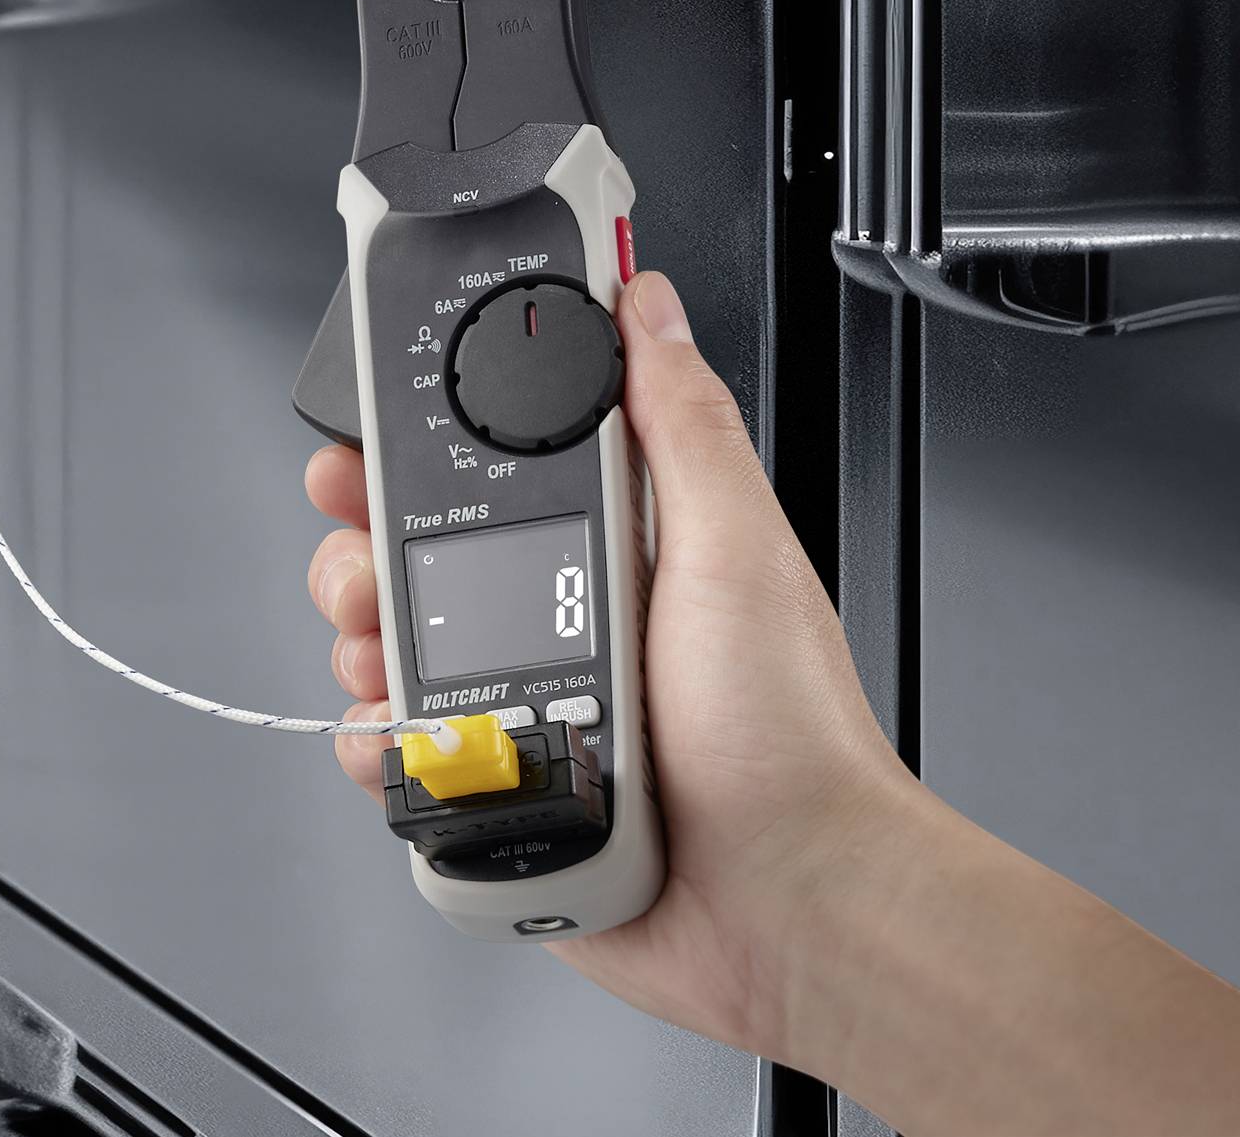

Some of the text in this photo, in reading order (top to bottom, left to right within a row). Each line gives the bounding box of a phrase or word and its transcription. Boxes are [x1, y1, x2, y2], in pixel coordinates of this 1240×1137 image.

[386, 19, 441, 42] CAT III
[497, 16, 535, 37] 160A
[398, 39, 432, 59] 600V
[453, 189, 479, 204] NCV
[507, 253, 549, 272] TEMP
[413, 373, 441, 389] CAP
[453, 455, 478, 470] Hz%
[487, 461, 516, 479] OFF
[403, 503, 489, 531] True RMS
[523, 673, 597, 696] VC515 160A
[422, 683, 510, 712] VOLTCRAFT
[559, 700, 581, 713] REL
[550, 707, 592, 722] INRUSH
